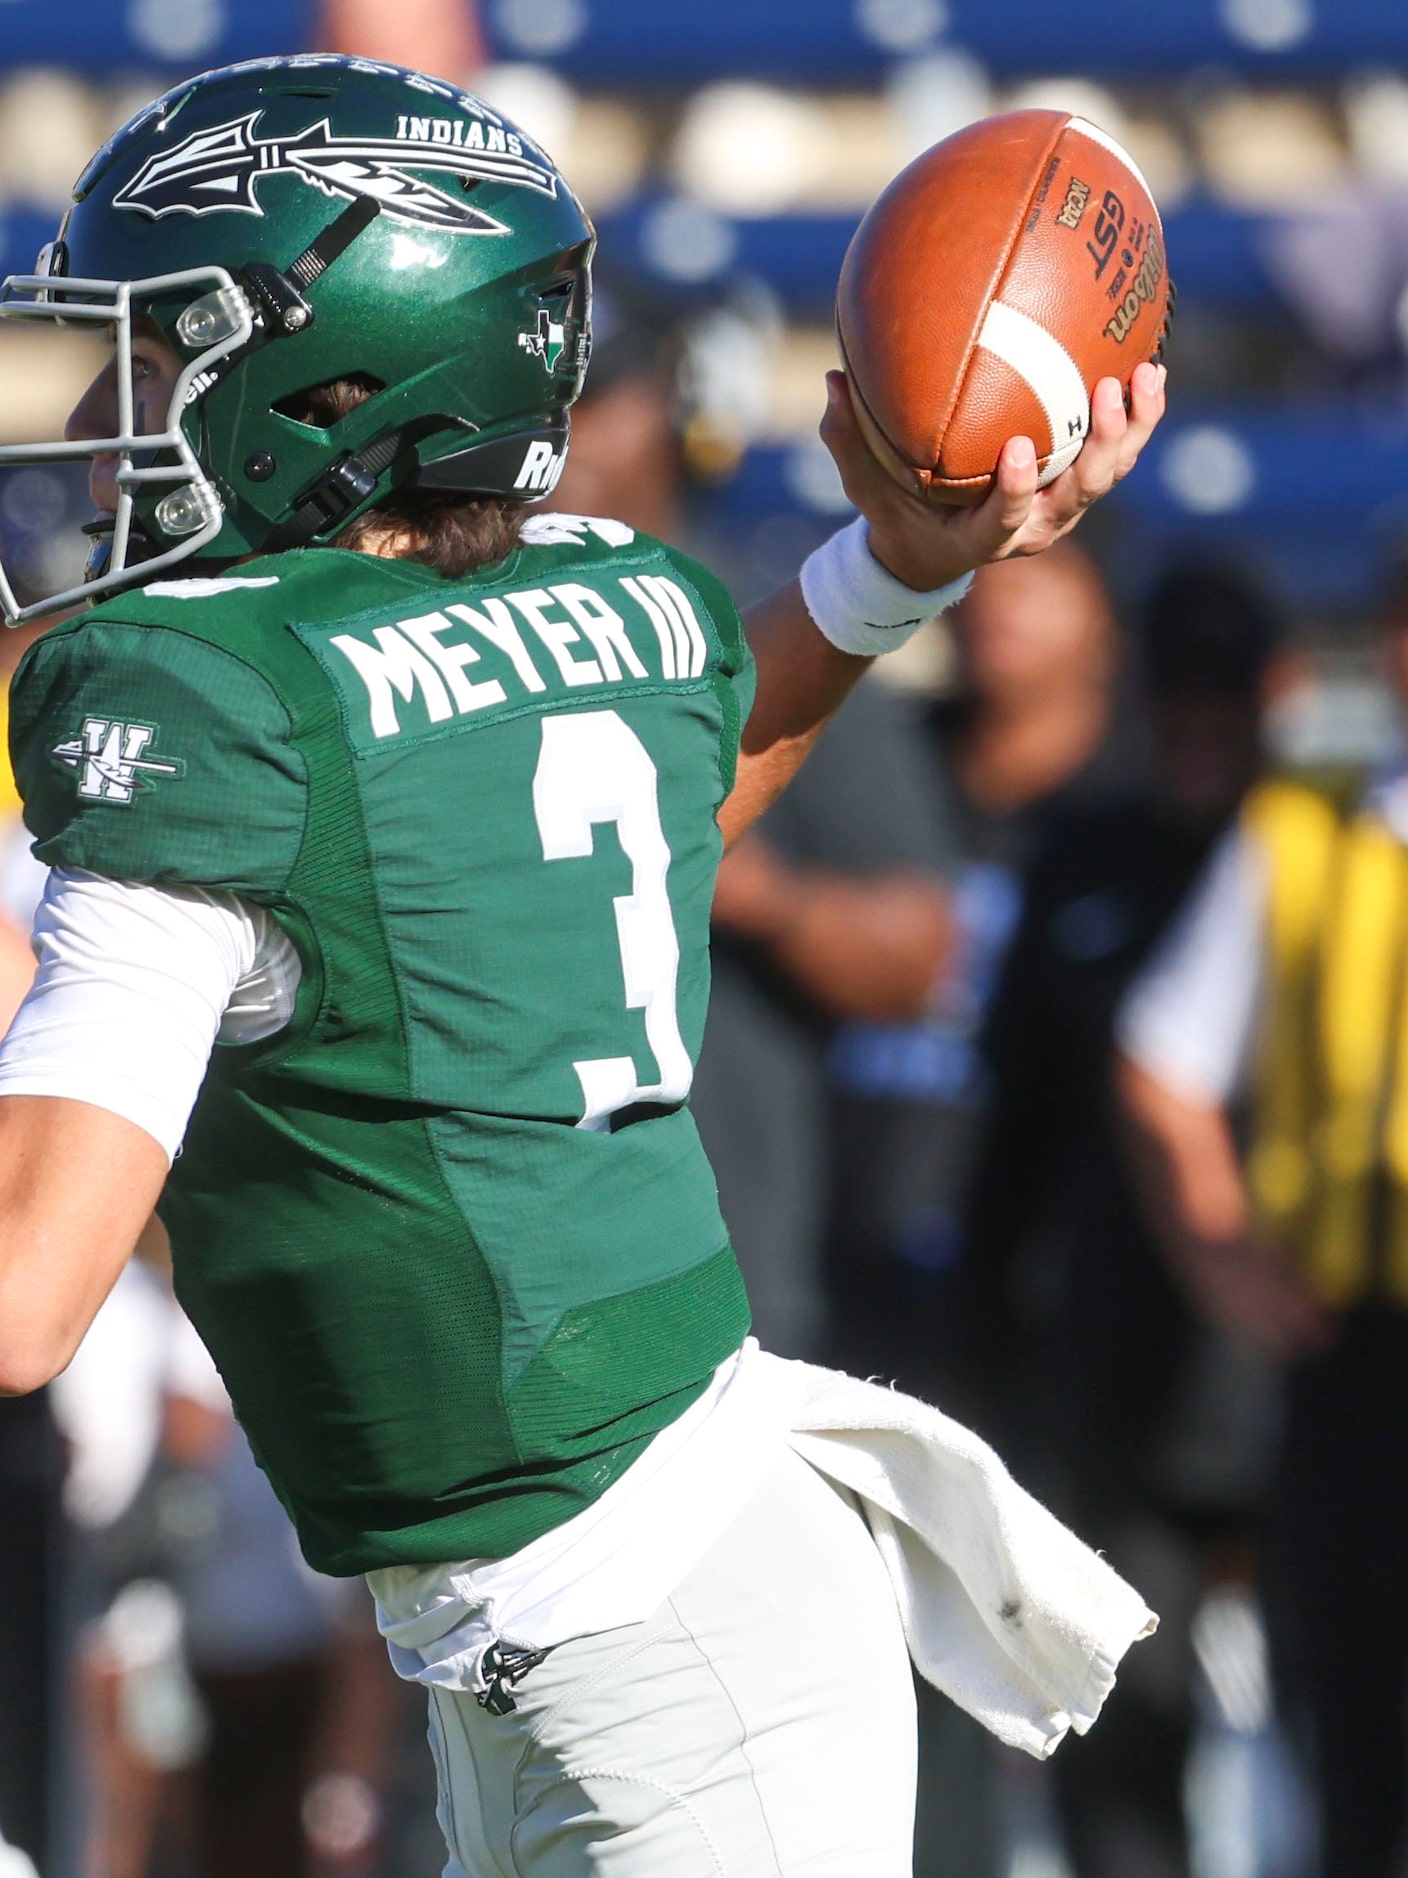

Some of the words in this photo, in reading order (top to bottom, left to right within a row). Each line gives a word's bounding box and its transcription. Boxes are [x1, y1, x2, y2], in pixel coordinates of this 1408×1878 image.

[396, 115, 523, 157] INDIANS
[1056, 176, 1090, 230] NCAA
[1086, 190, 1125, 281] GST
[1103, 223, 1165, 344] Wilson
[330, 583, 649, 739] MEYER
[617, 575, 708, 681] III
[533, 710, 693, 1133] 3
